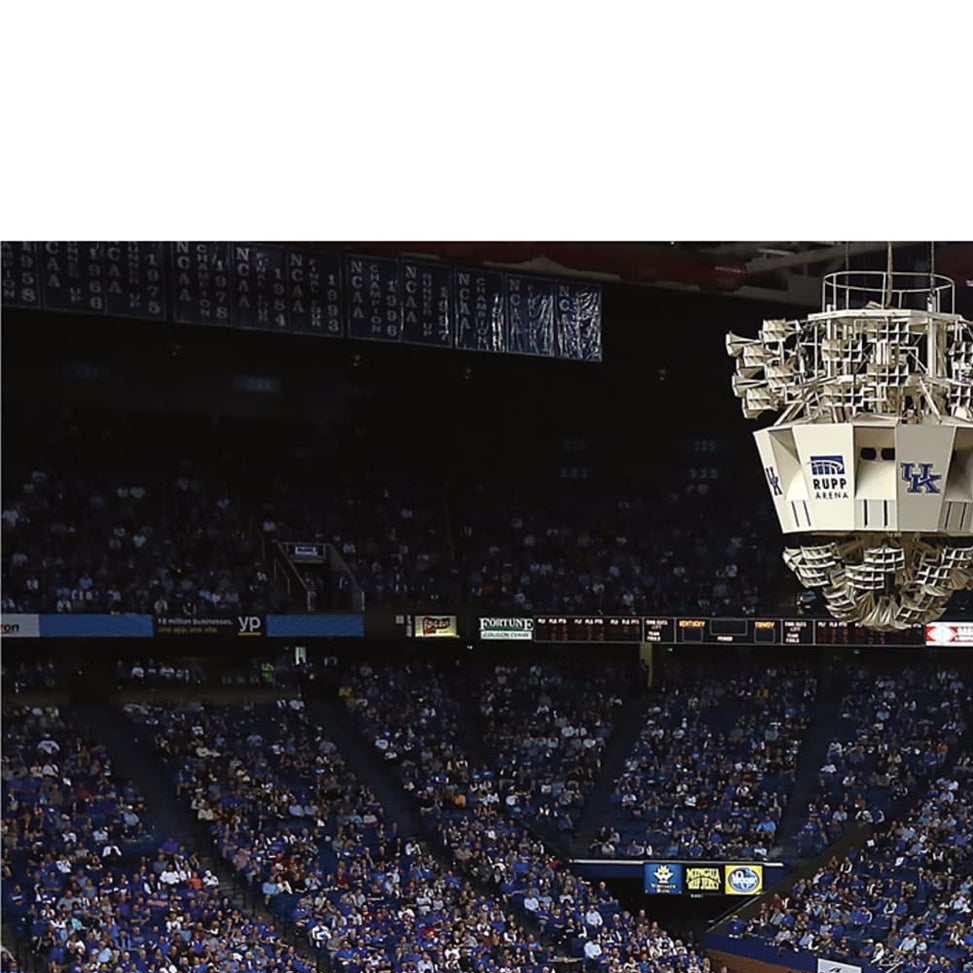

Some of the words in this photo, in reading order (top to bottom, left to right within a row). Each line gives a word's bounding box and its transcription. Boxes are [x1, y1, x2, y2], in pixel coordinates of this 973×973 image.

[45, 242, 61, 288] CAA
[236, 247, 250, 308] NCAA
[290, 252, 304, 313] NCAA
[351, 260, 364, 320] NCAA
[405, 266, 418, 324] NCAA
[813, 478, 847, 490] RUPP
[815, 491, 849, 500] ARENA
[238, 616, 262, 633] yp
[479, 617, 534, 631] FORTUNE
